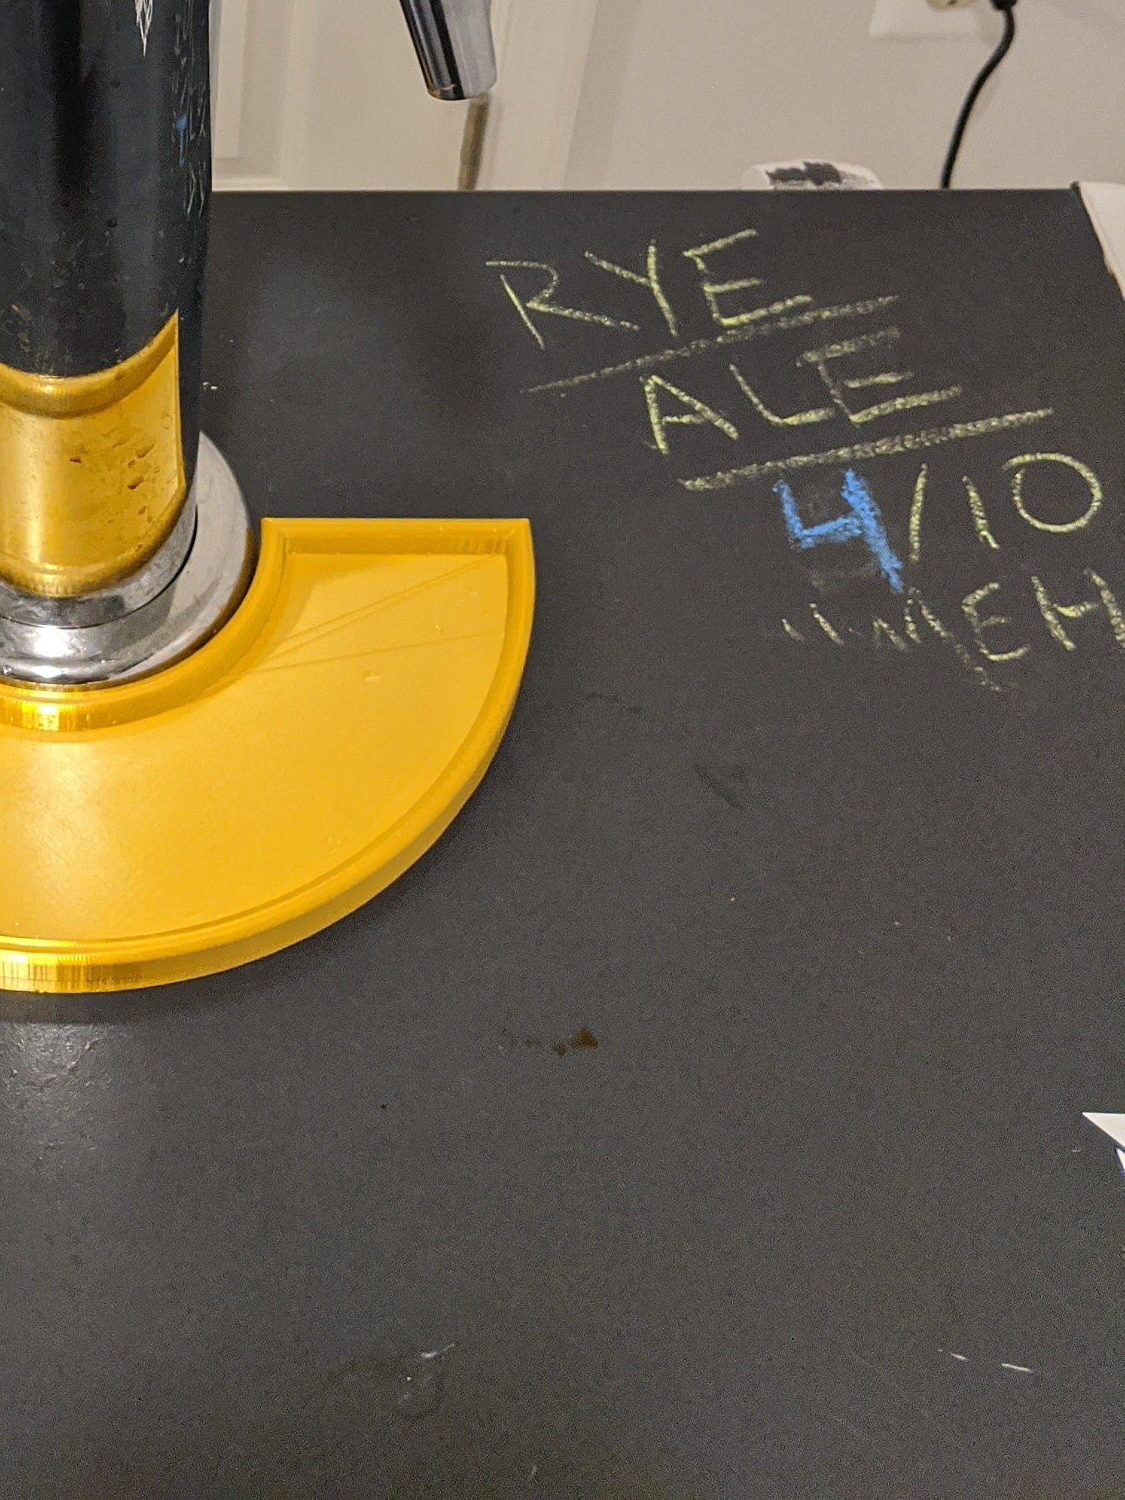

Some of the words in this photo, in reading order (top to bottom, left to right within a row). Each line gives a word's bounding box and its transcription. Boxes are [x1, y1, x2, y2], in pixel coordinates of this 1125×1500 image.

[485, 229, 815, 350] RYE
[641, 328, 963, 456] ALE
[772, 452, 1103, 593] 4/10
